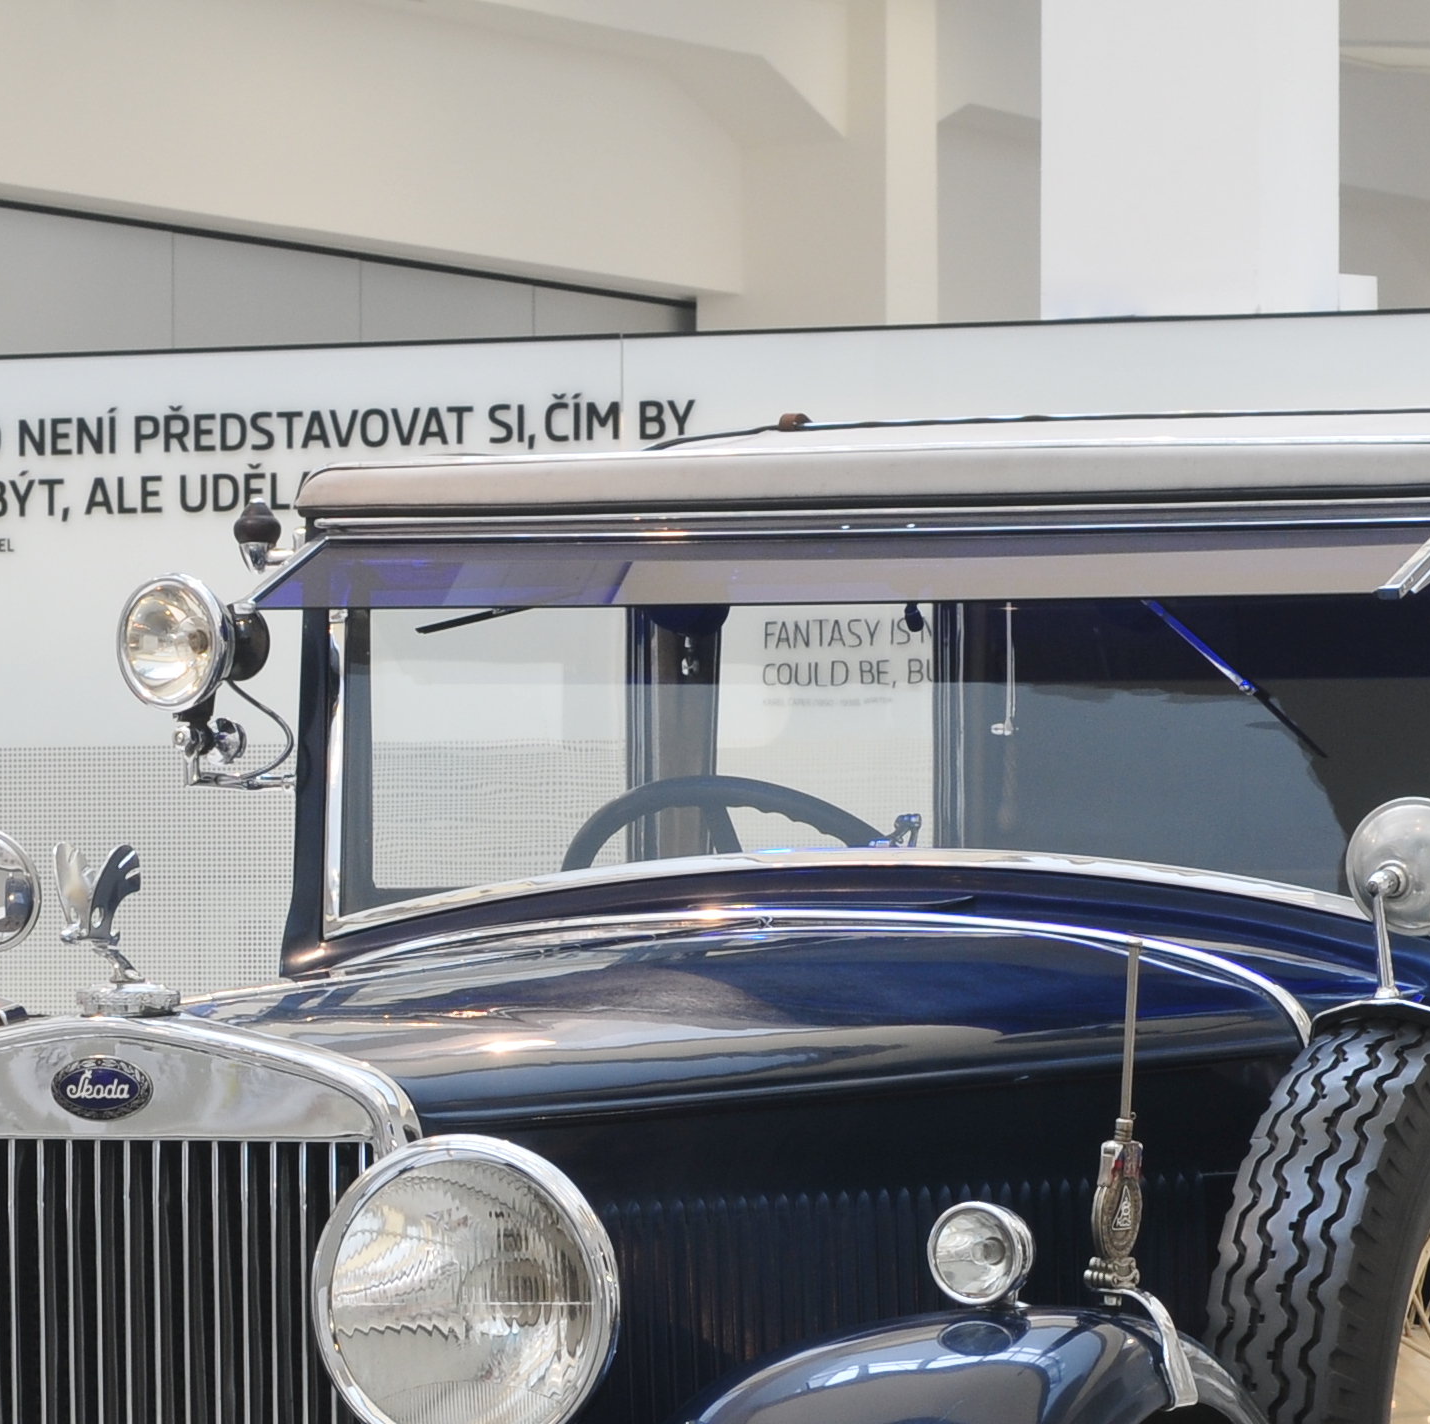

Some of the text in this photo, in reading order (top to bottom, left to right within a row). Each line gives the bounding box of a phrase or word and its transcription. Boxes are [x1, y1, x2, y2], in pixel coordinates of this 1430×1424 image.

[18, 407, 118, 457] NENÍ
[134, 405, 474, 454] PŘEDSTAVOVAT
[488, 403, 536, 450] SI,
[544, 392, 620, 443] ČÍM
[638, 399, 696, 441] BY
[84, 475, 163, 515] ALE
[180, 463, 310, 513] UDĚL
[764, 618, 881, 650] FANTASY
[890, 617, 911, 646] IS
[762, 660, 850, 687] COULD
[859, 659, 897, 689] BE,
[66, 1068, 130, 1099] Škoda
